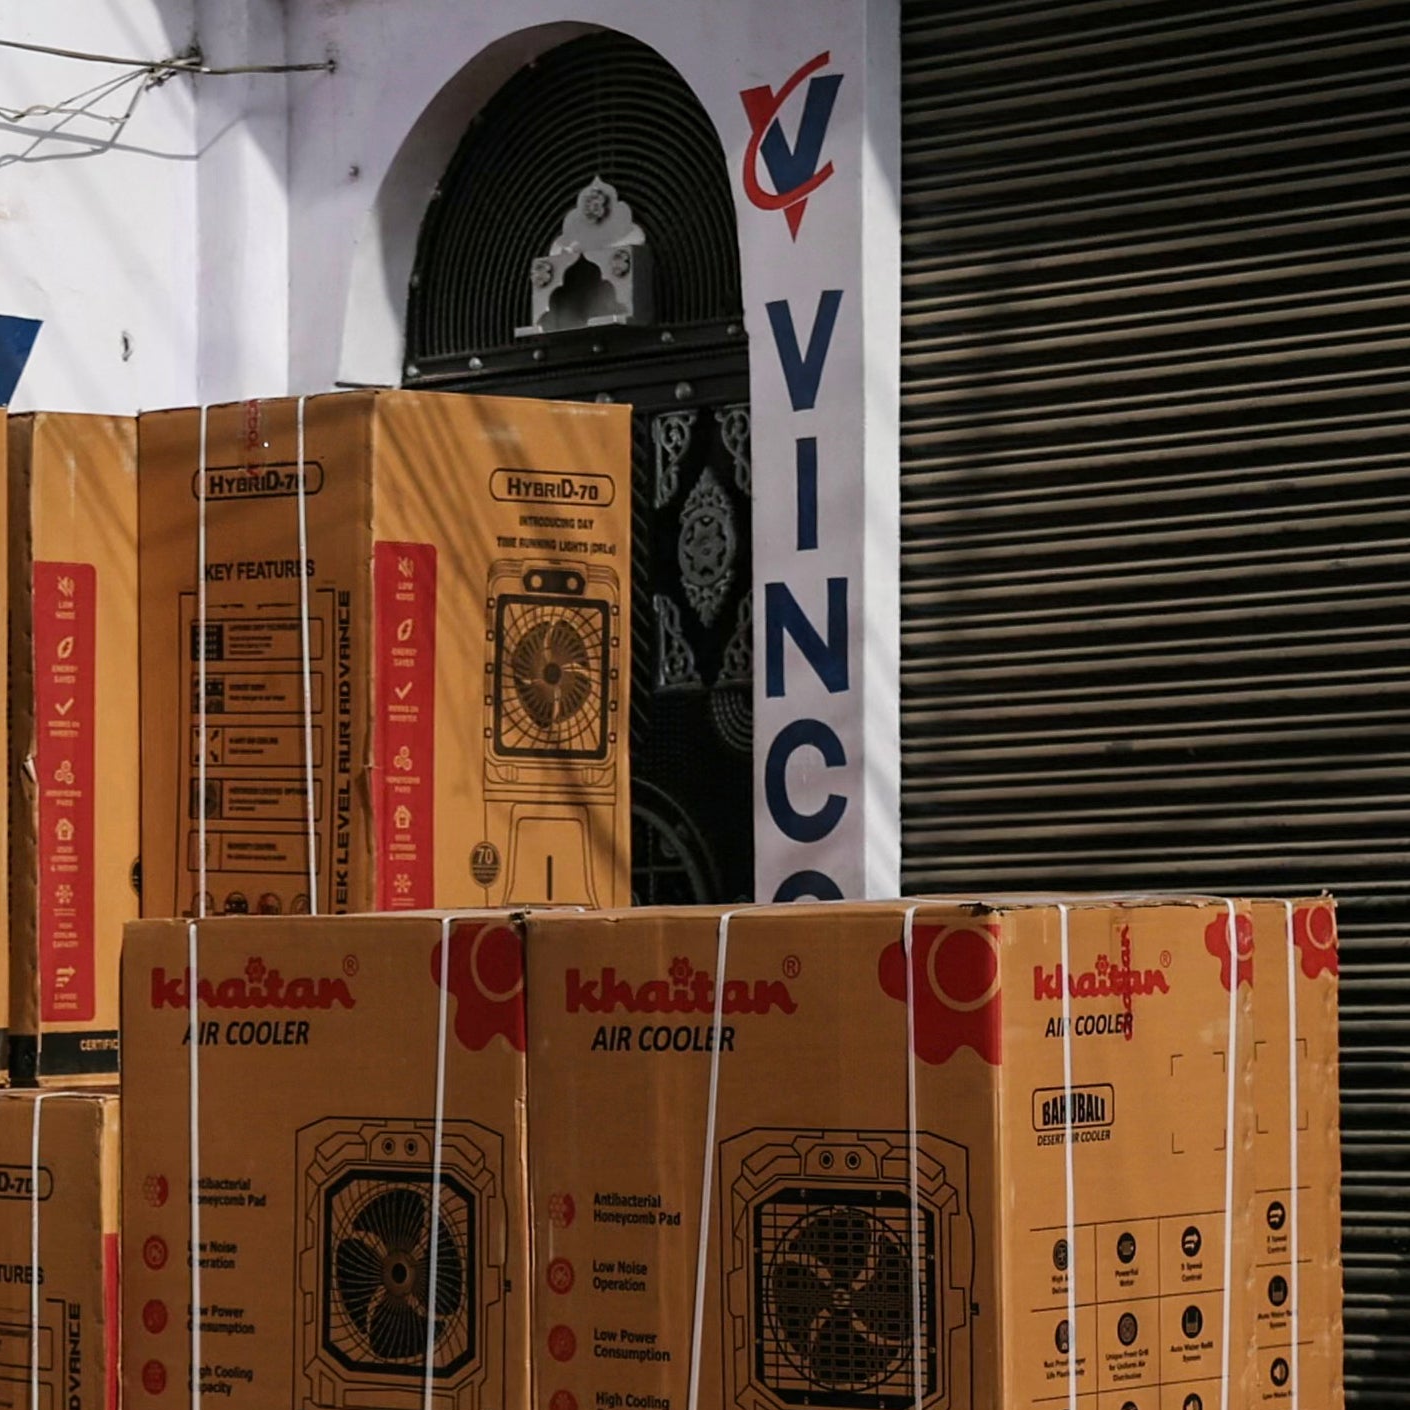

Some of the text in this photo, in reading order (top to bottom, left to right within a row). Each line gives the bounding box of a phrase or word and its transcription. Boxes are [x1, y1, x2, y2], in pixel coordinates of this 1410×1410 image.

[507, 477, 599, 501] HYBRID-70
[519, 515, 594, 530] INTRODUCING DAY
[559, 540, 589, 554] LIGHTS
[205, 562, 234, 582] KEY
[338, 590, 351, 716] ADVANCE
[337, 779, 351, 865] LEVEL
[476, 848, 493, 864] 70
[151, 956, 356, 1010] khaitan
[565, 956, 799, 1014] khaitan
[1033, 954, 1170, 1000] khaitan
[182, 1020, 310, 1046] AIR COOLER
[1045, 1013, 1133, 1038] AIR COOLER
[80, 1039, 118, 1051] CERTIFIC
[591, 1025, 736, 1052] AIR COOLER
[1042, 1092, 1105, 1126] BAHUBALI
[1037, 1130, 1111, 1147] DESERT COOLER
[248, 1194, 267, 1208] Pad
[593, 1192, 661, 1208] Antibacterial
[593, 1209, 681, 1226] Honeycomb Pad
[210, 1240, 238, 1254] Noise
[593, 1260, 648, 1276] Low Noise
[1115, 1268, 1139, 1278] Powerful
[593, 1276, 646, 1292] Operation
[211, 1304, 245, 1319] Power
[594, 1328, 657, 1345] Low Power
[594, 1345, 671, 1363] Consumption
[214, 1365, 254, 1382] Cooling
[596, 1392, 623, 1408] High
